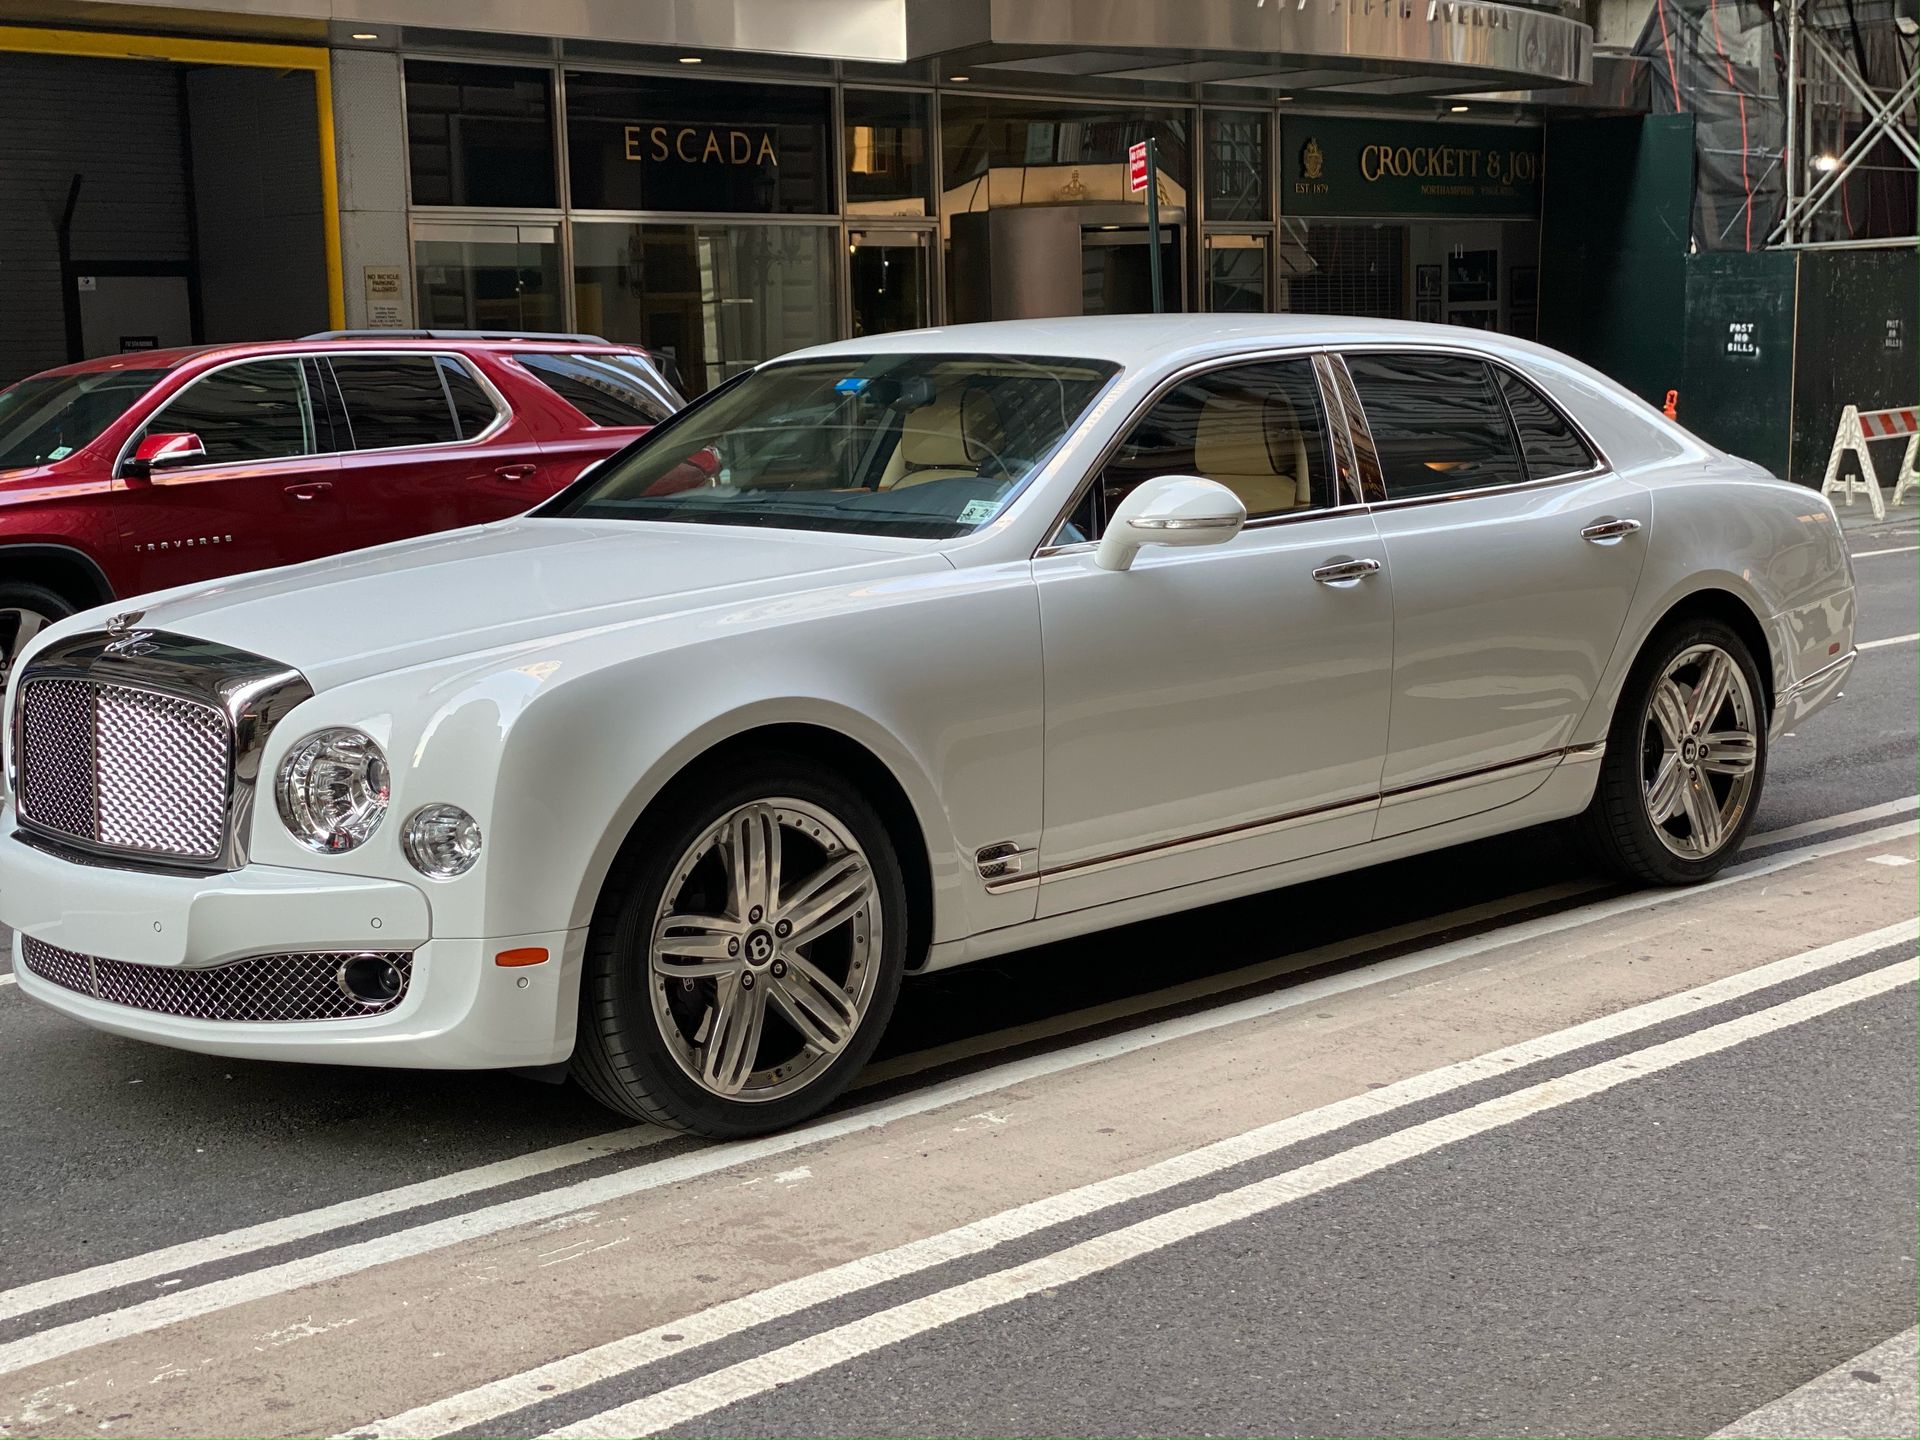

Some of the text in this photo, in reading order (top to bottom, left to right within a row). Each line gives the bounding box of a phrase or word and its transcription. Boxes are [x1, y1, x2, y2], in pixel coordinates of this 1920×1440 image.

[1426, 0, 1510, 31] AVENUE
[624, 126, 778, 167] ESCADA
[1361, 145, 1481, 181] CROCKETT
[1487, 150, 1500, 178] &
[1729, 323, 1754, 333] POST
[1734, 333, 1749, 342] NO
[1727, 342, 1754, 352] BILLS
[134, 534, 232, 552] TRAVERSE
[749, 934, 771, 961] B
